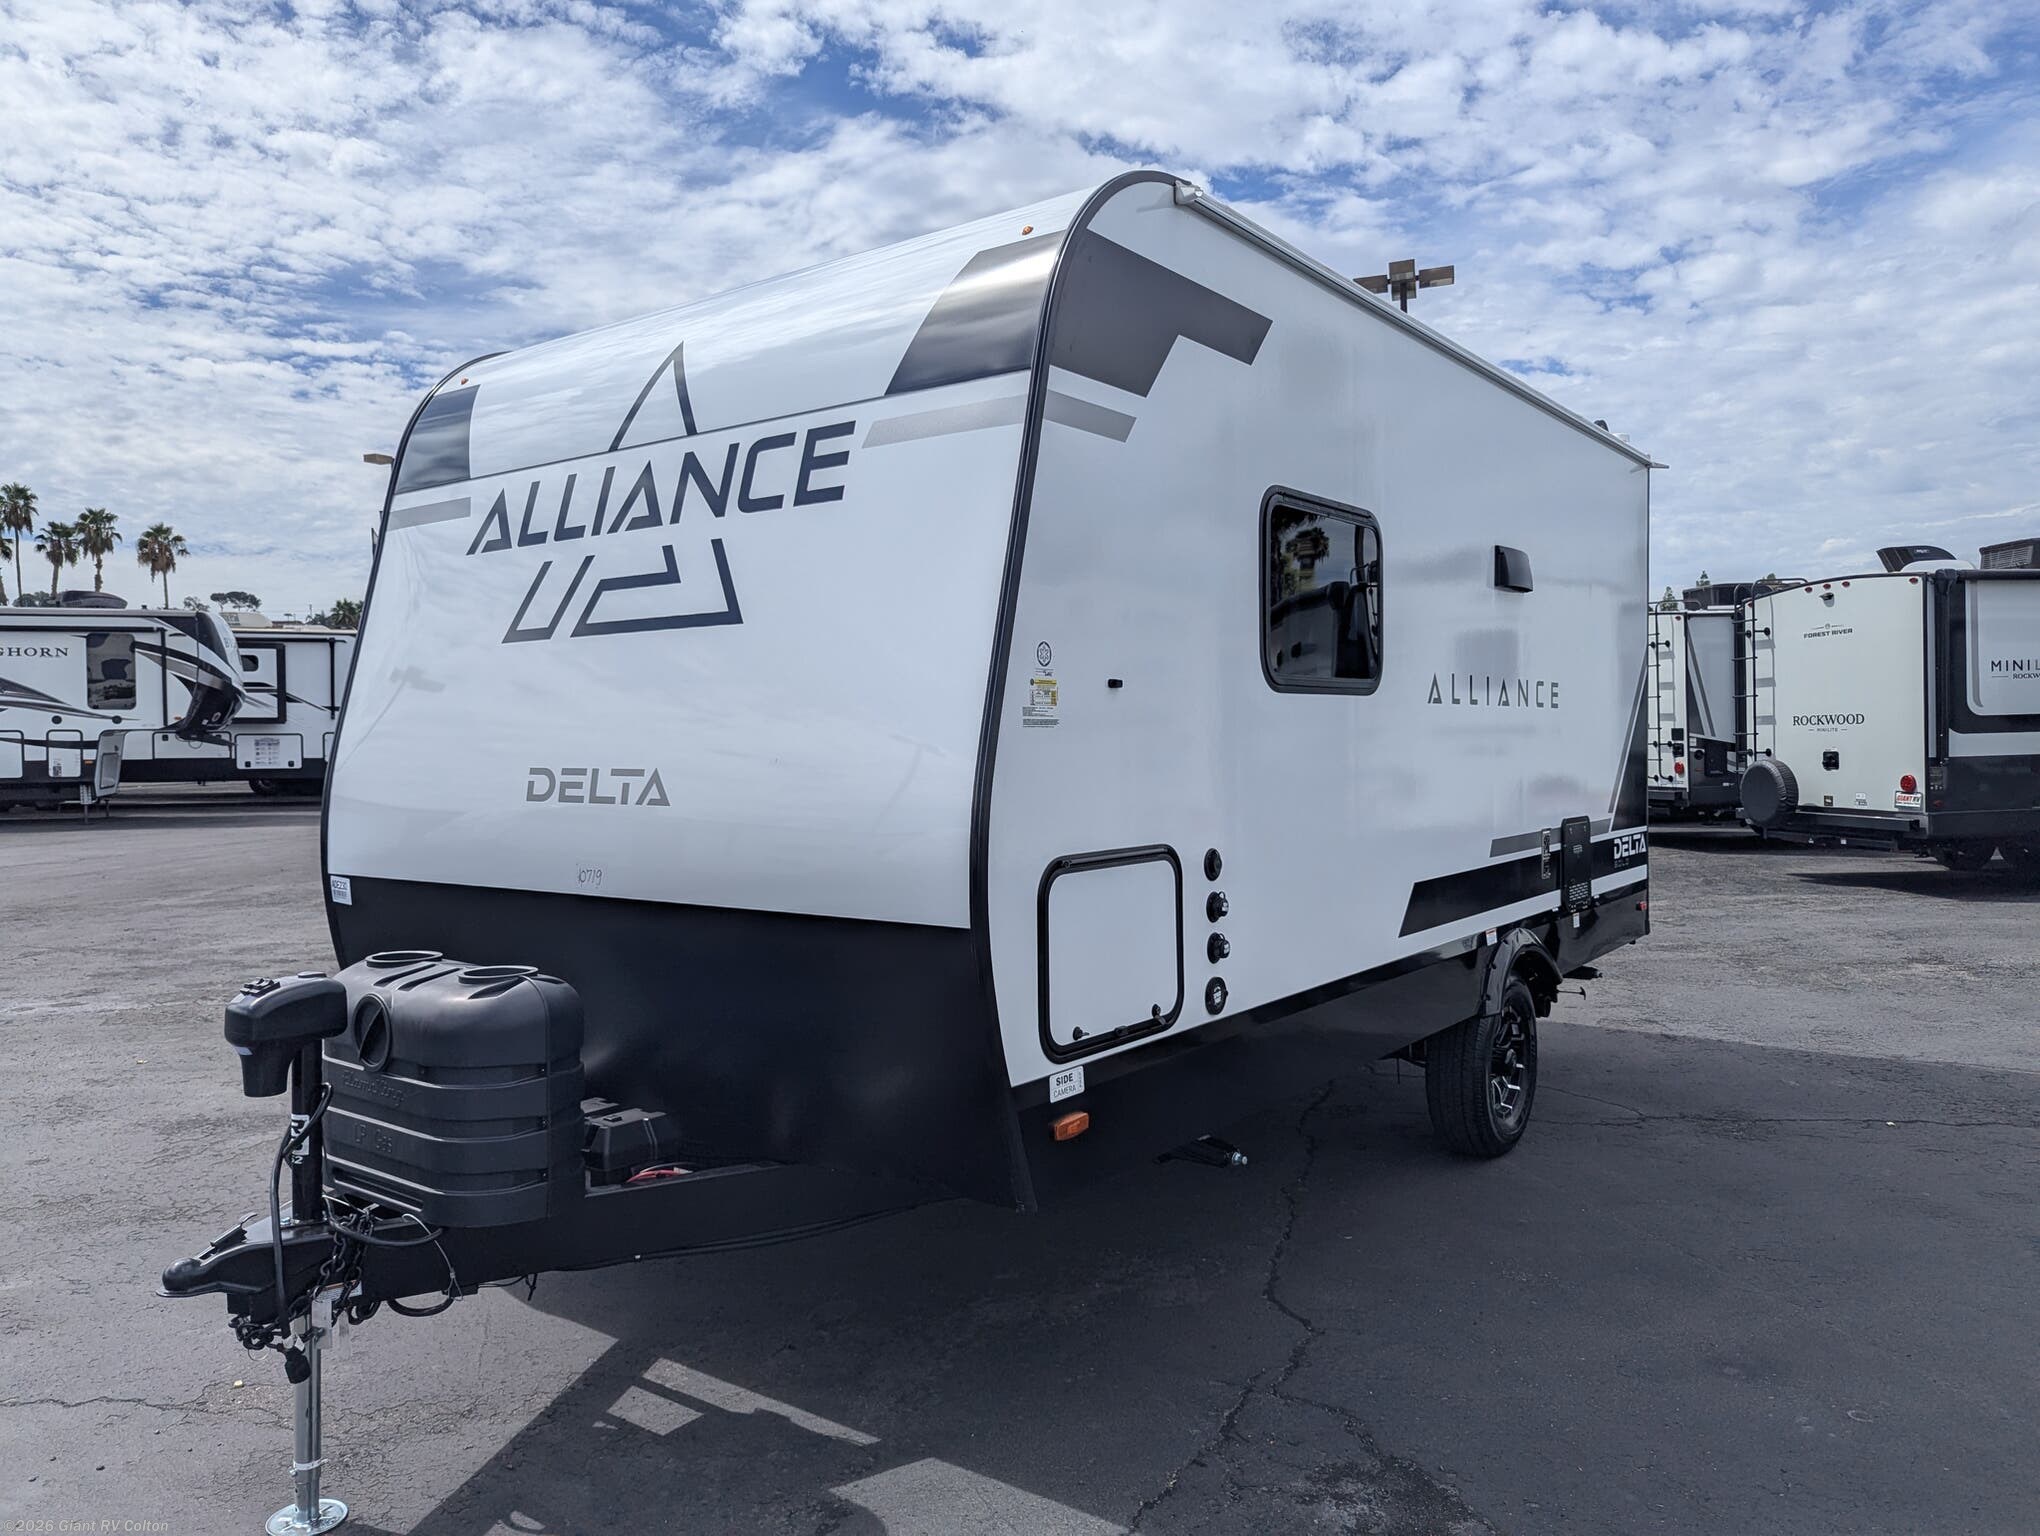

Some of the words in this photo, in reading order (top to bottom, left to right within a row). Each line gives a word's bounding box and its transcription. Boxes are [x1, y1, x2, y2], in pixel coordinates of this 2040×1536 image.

[466, 420, 856, 556] ALLIANCE
[1803, 631, 1830, 639] FOREST
[1832, 628, 1853, 636] RIVER
[1427, 672, 1559, 709] ALLIANCE
[1792, 713, 1865, 726] ROCKWOOD
[526, 767, 671, 807] DELTA
[1613, 833, 1647, 860] DELTA
[1056, 1073, 1074, 1086] SIDE
[1053, 1084, 1077, 1098] CAMERA
